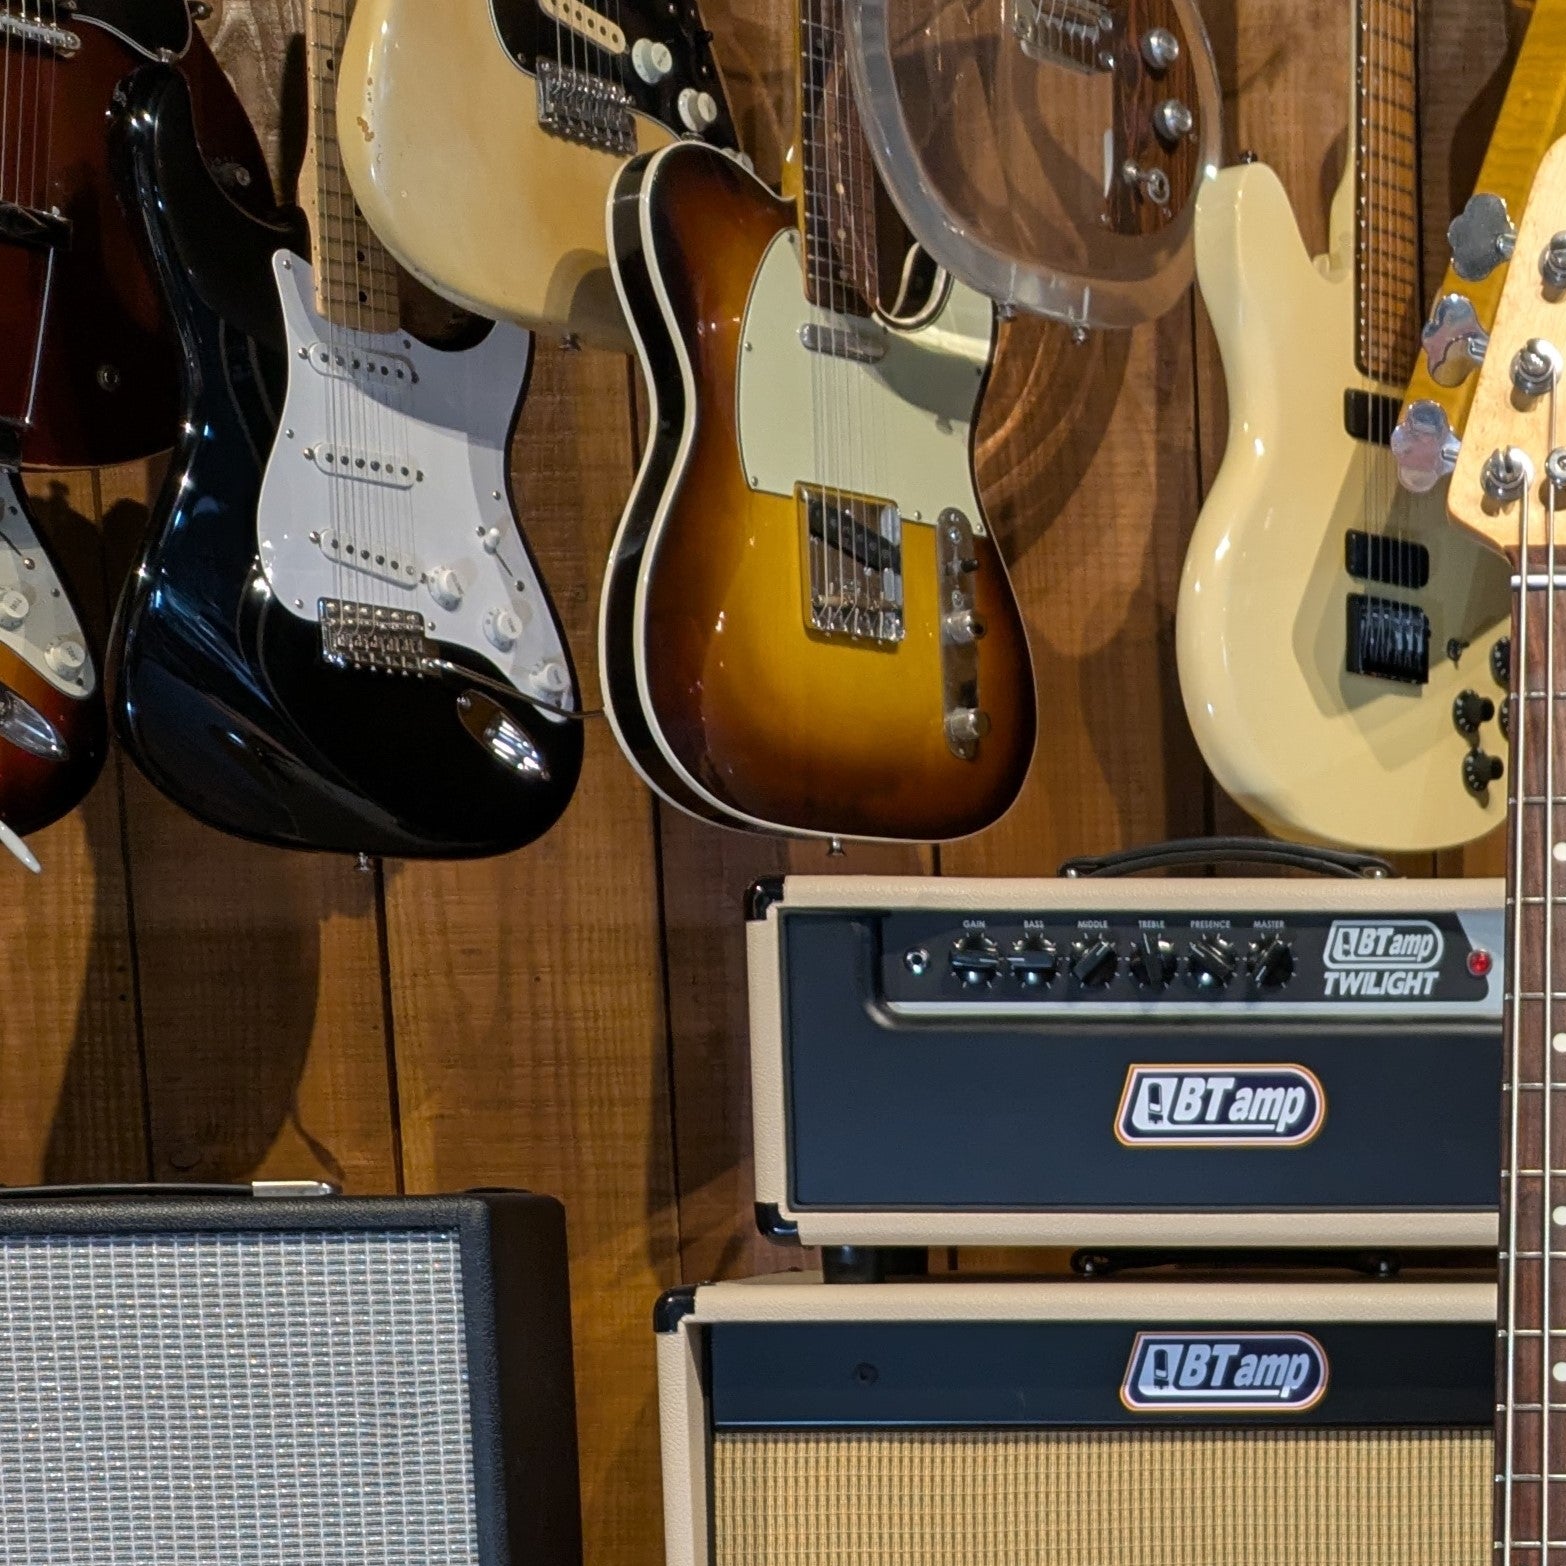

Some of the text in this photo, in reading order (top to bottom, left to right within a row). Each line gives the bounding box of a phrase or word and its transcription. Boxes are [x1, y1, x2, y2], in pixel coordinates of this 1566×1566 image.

[962, 920, 985, 928] GAIN
[1023, 920, 1044, 928] BASS
[1077, 920, 1108, 928] MIDDLE
[1138, 920, 1165, 928] TREBLE
[1190, 920, 1231, 928] PRESENCE
[1253, 920, 1285, 928] MASTER
[1323, 971, 1440, 995] TWILIGHT
